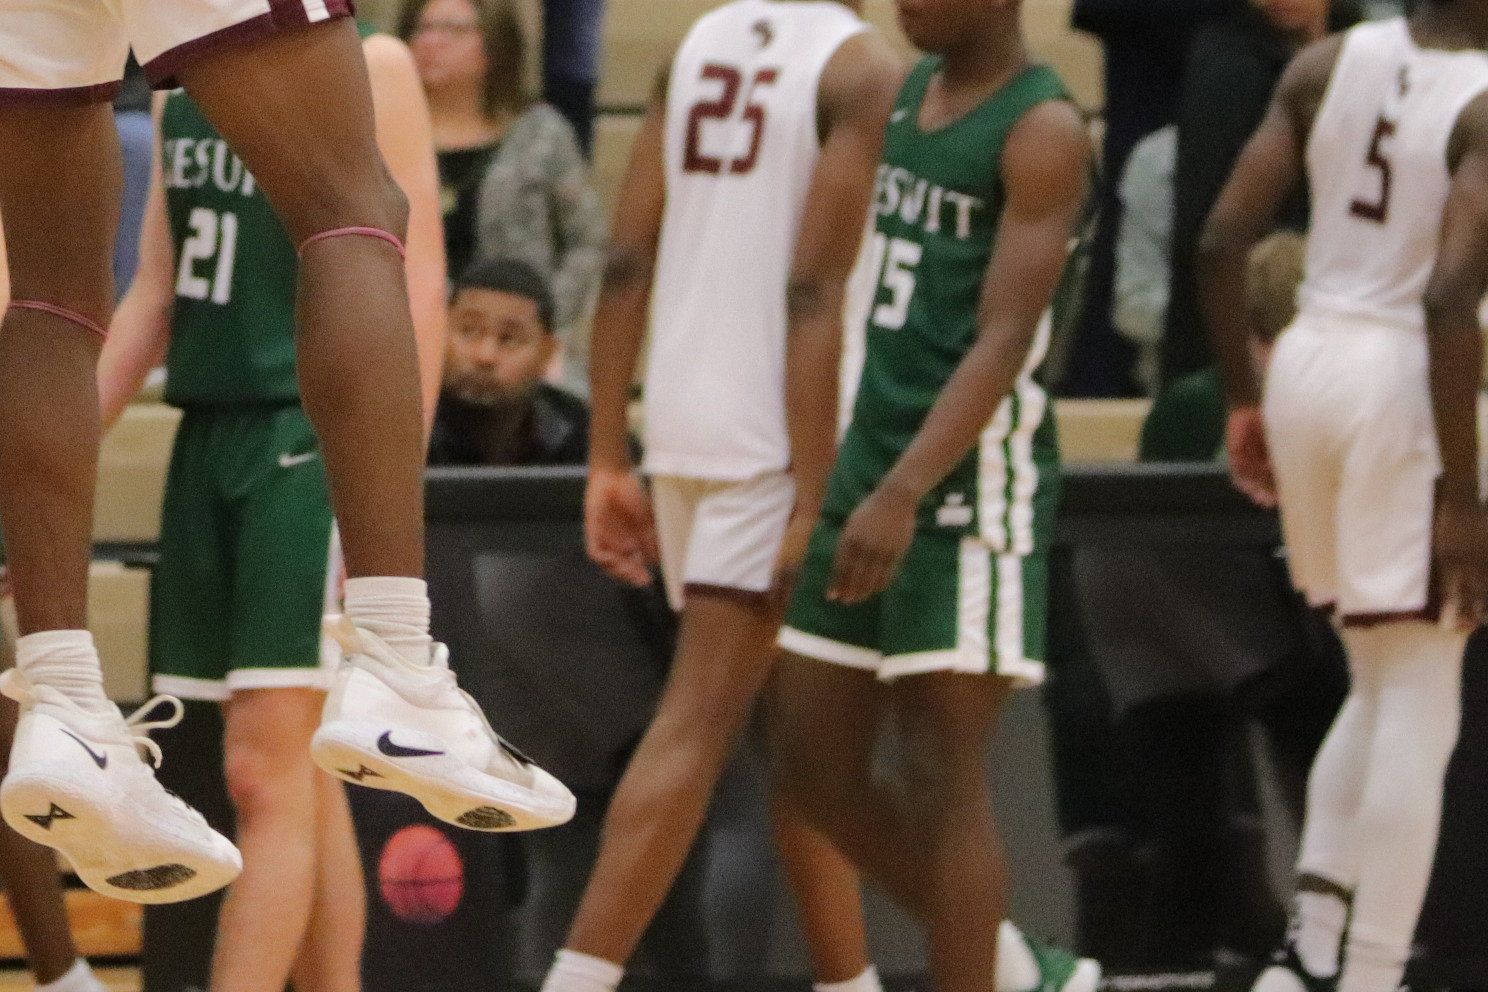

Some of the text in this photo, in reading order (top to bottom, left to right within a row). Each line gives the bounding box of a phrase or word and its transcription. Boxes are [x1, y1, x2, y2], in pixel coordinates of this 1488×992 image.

[683, 63, 780, 175] 25
[1350, 114, 1396, 223] 5
[176, 207, 237, 305] 21
